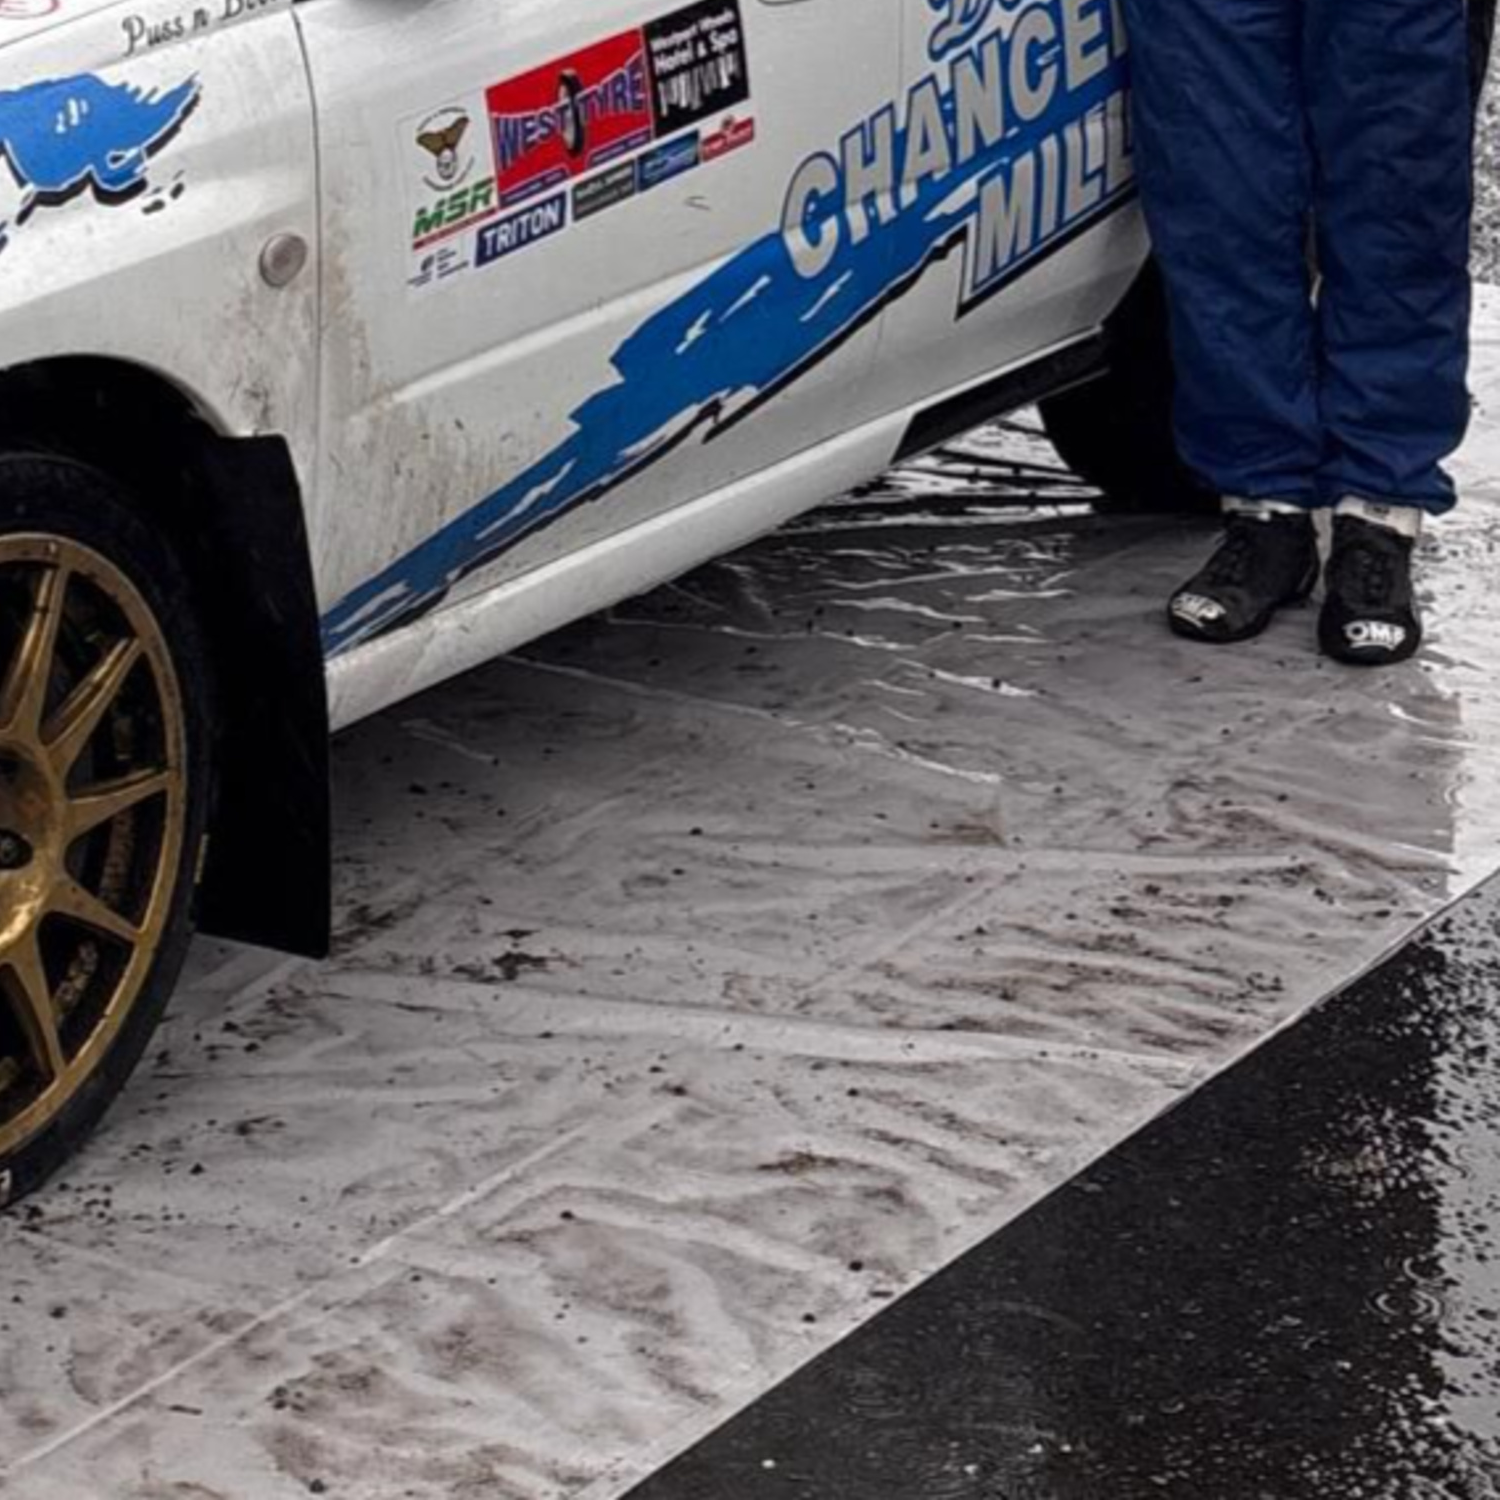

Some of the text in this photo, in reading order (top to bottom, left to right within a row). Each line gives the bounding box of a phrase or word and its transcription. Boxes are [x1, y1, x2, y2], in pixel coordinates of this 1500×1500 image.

[121, 15, 185, 57] Puss
[972, 88, 1135, 294] MILL
[482, 198, 562, 257] TRITON
